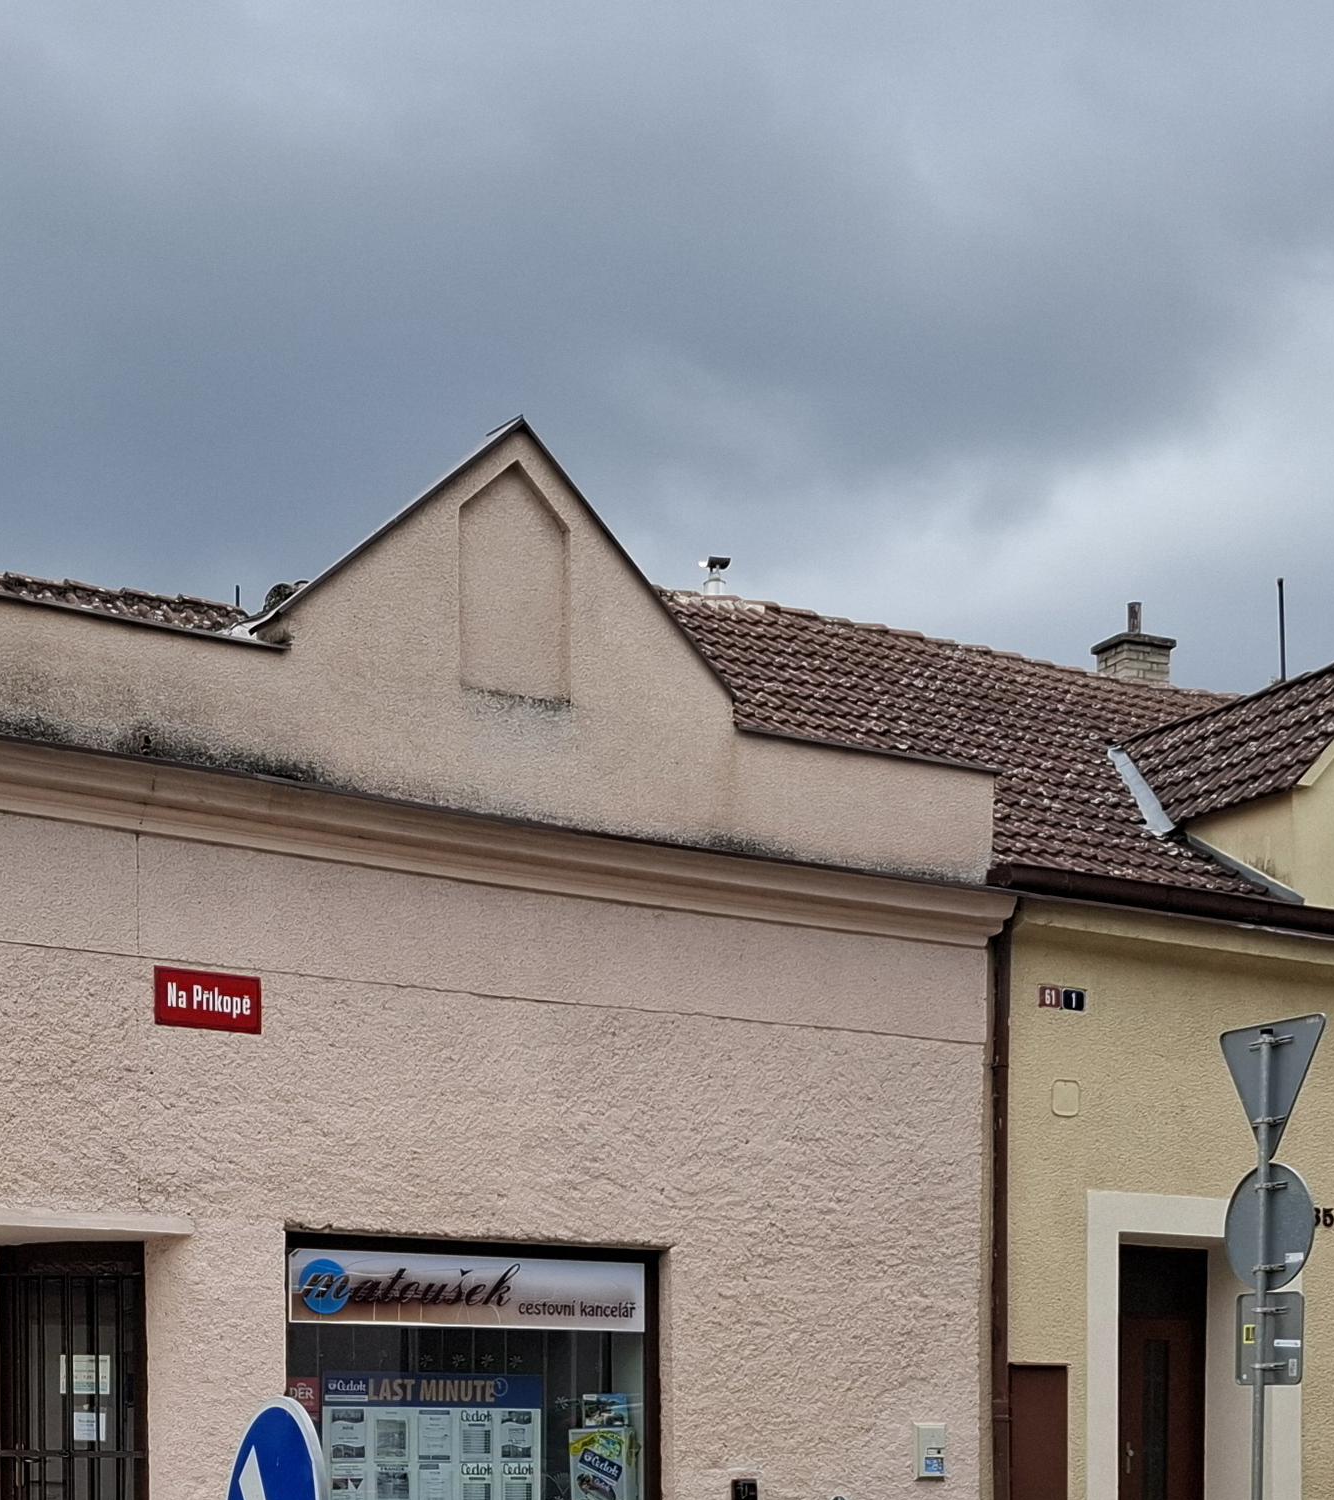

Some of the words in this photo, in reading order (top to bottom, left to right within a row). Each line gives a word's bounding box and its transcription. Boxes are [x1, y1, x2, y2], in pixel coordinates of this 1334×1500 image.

[167, 981, 187, 1009] Na
[1044, 988, 1056, 1006] 61
[1071, 992, 1076, 1009] 1
[301, 1263, 521, 1307] matoušek
[518, 1300, 576, 1317] cestovní
[579, 1302, 637, 1319] kancelář
[289, 1386, 315, 1400] DER
[367, 1378, 416, 1401] LAST
[419, 1379, 496, 1403] MINUTE
